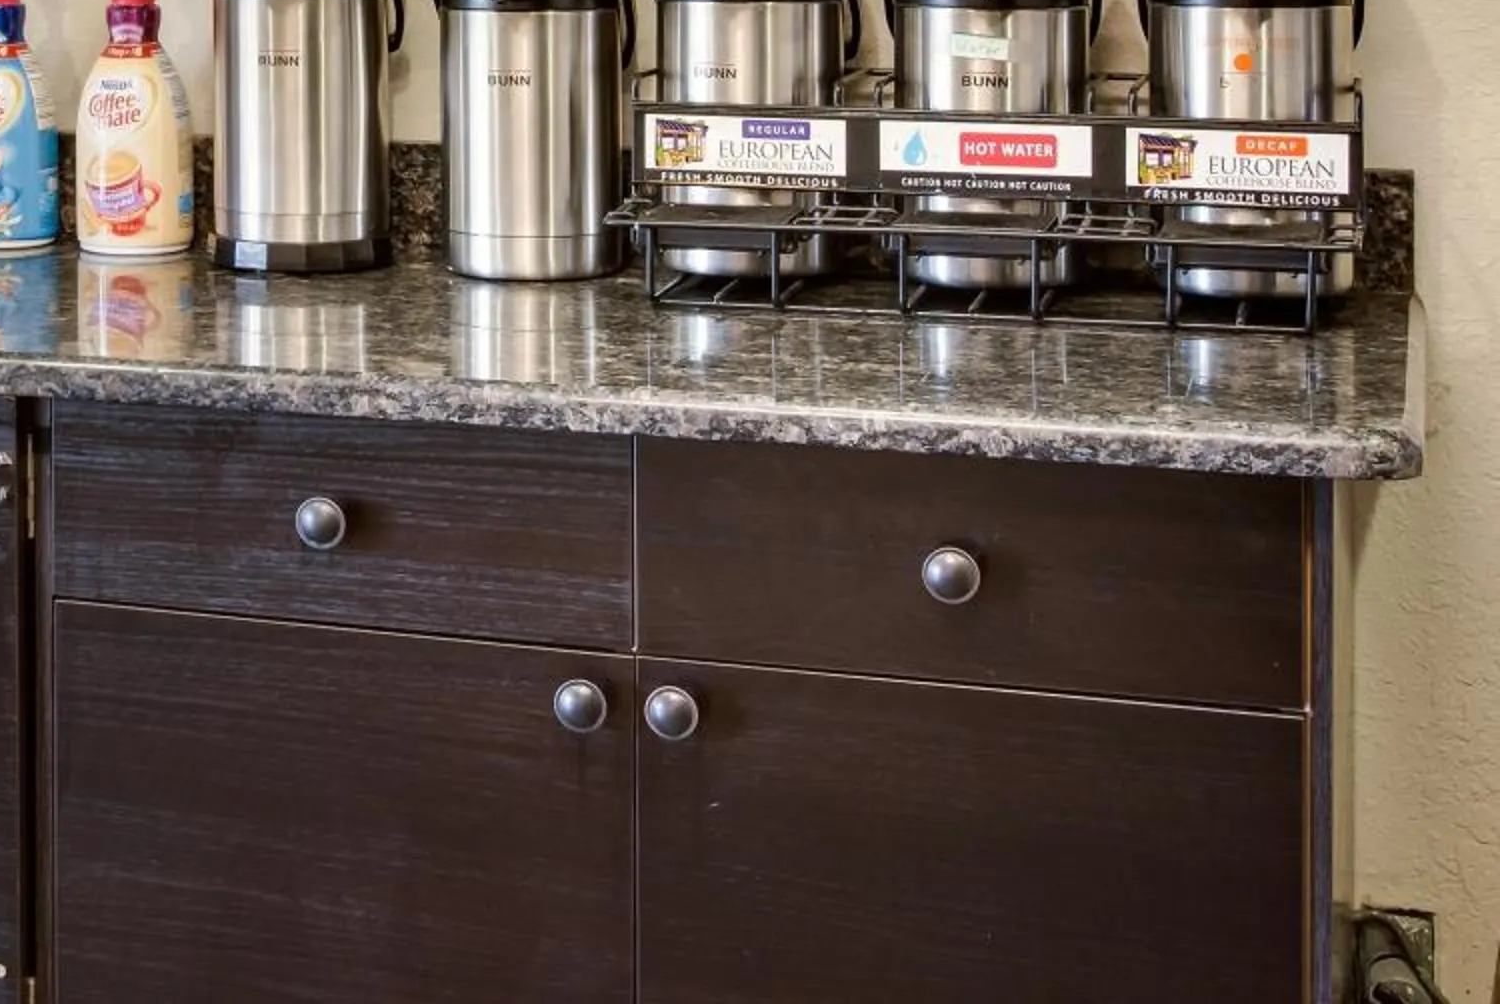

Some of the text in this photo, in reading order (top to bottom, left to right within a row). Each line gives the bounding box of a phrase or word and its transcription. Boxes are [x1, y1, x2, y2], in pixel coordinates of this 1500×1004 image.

[258, 55, 299, 66] BUNN
[488, 75, 531, 86] BUNN
[961, 75, 1009, 88] BUNN
[747, 124, 806, 136] REGULAR
[719, 139, 834, 161] EUROPEAN
[963, 141, 1054, 158] HOT WATER
[1245, 139, 1298, 151] DECAF
[796, 162, 836, 173] BLEND
[1208, 155, 1336, 178] EUROPEAN
[661, 171, 839, 188] FRESH SMOOTH DELICIOUS
[901, 177, 1072, 192] CAUTION HOT CAUTION HOT CAUTION
[1205, 176, 1337, 190] COFFEEHOUSE BLEND
[1144, 188, 1340, 207] FRESH SMOOTH DELICIOUS
